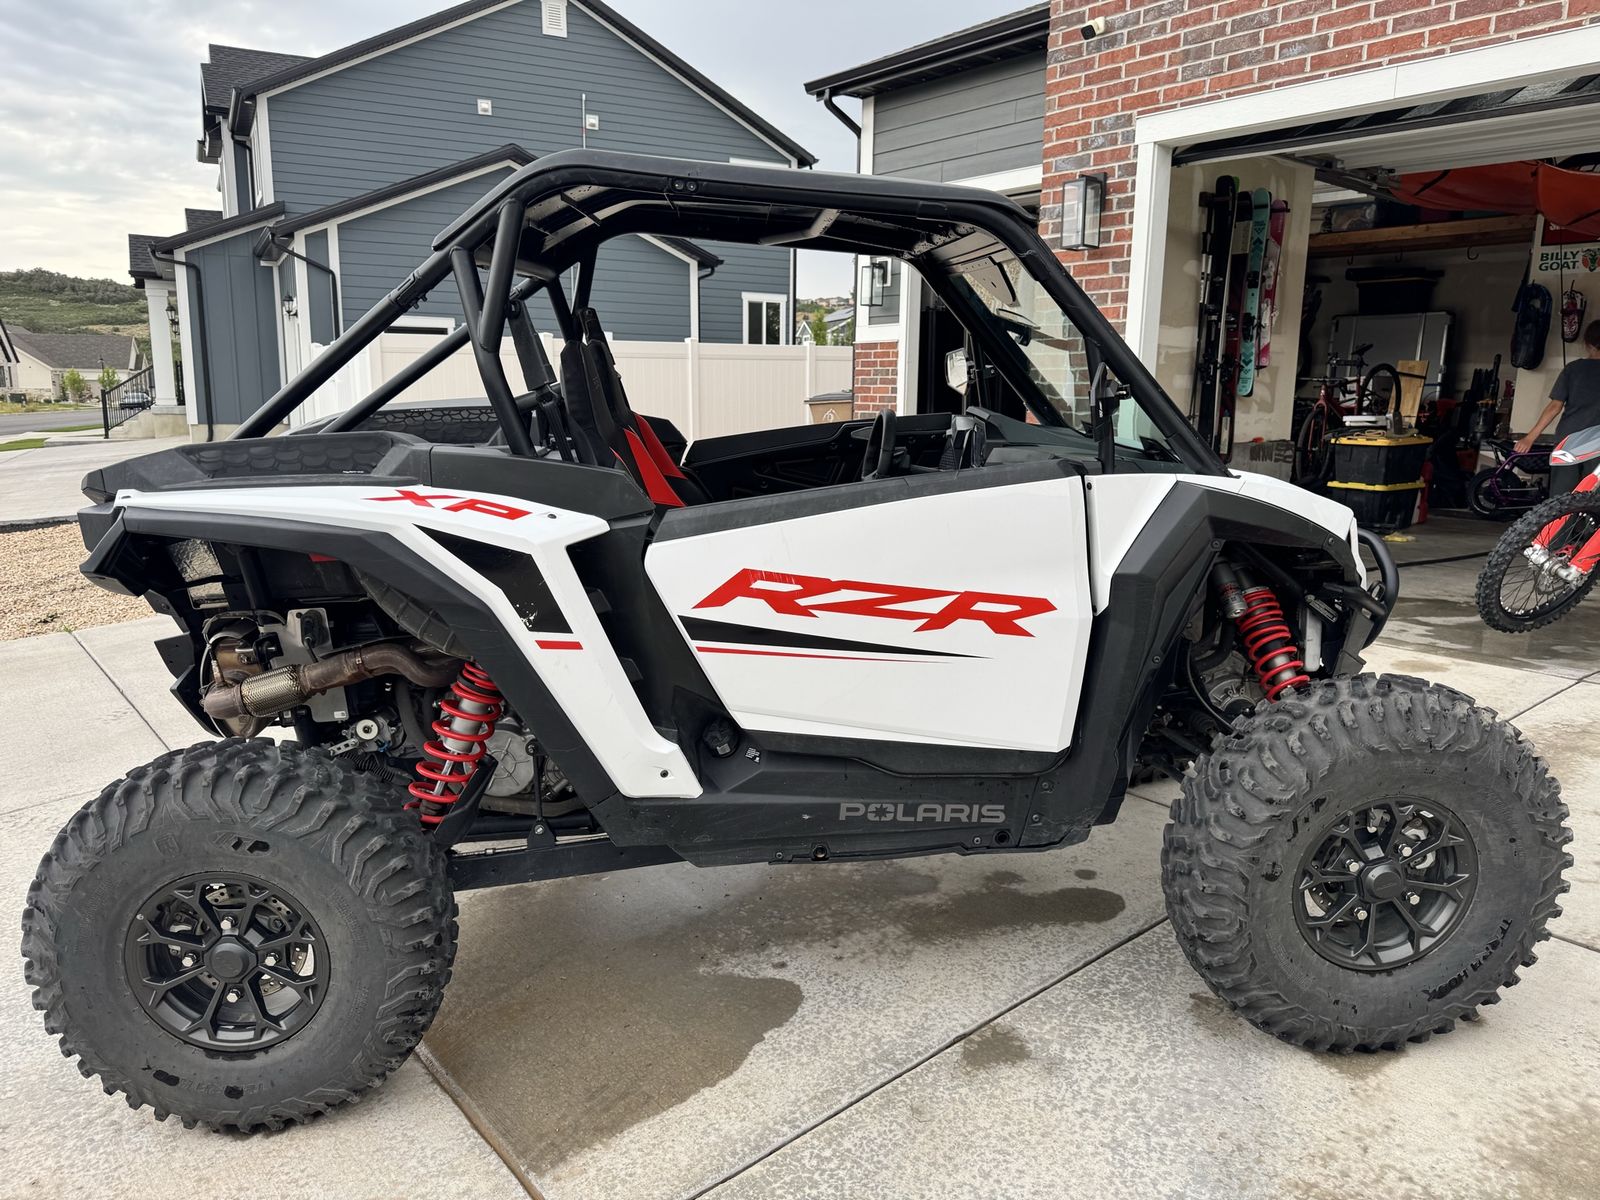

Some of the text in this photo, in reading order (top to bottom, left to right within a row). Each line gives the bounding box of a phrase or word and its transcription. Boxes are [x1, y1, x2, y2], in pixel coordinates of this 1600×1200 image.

[1539, 261, 1579, 271] GOAT
[1540, 251, 1579, 261] BILLY
[361, 489, 533, 521] XP
[692, 567, 1058, 638] RZR
[838, 801, 1007, 824] POLARIS
